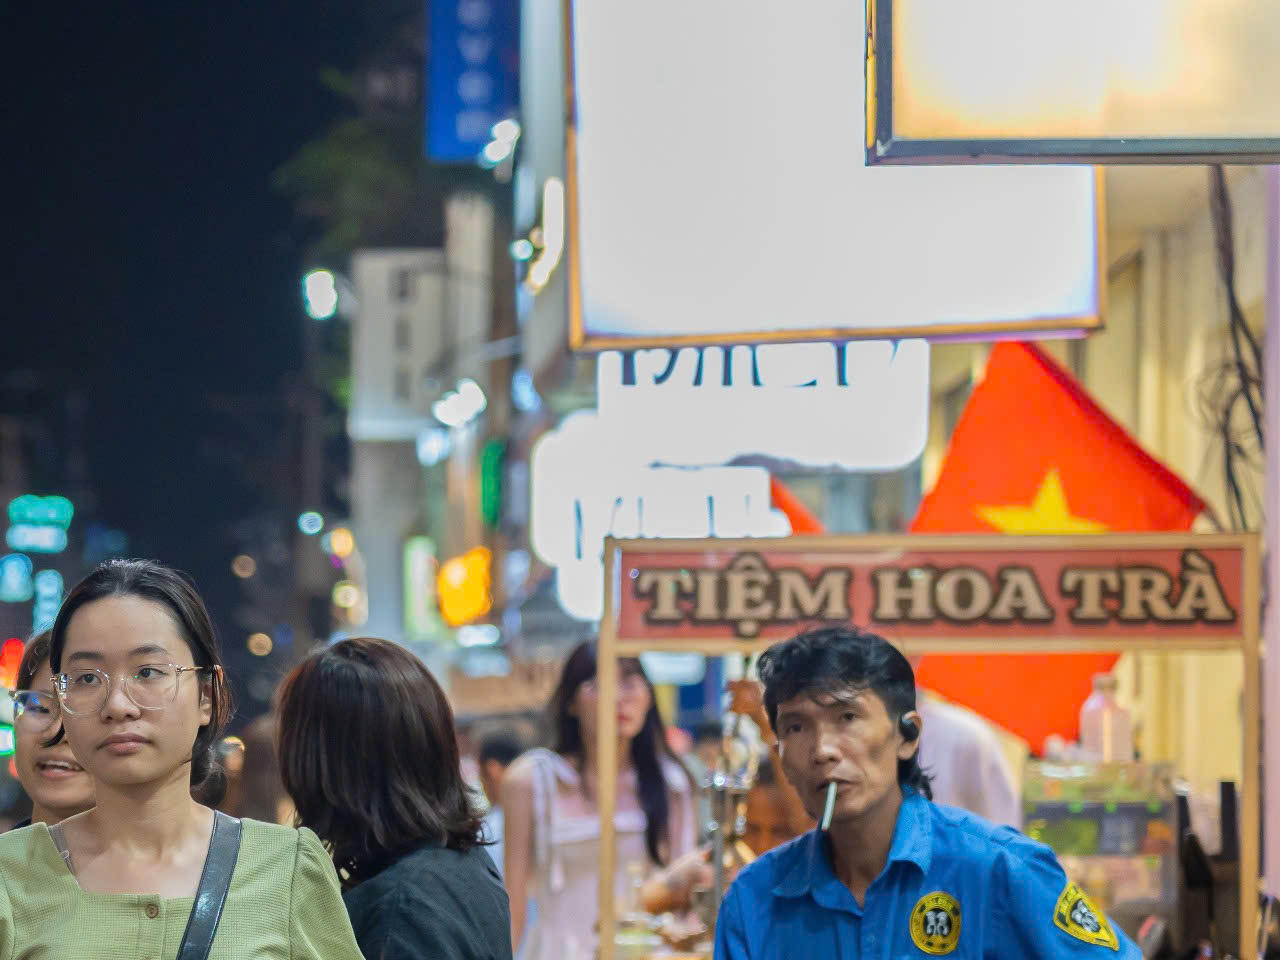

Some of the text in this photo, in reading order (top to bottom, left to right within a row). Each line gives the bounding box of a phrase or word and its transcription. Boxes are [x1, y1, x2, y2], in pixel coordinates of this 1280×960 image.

[634, 549, 1235, 639] TIỆM HOA TRÀ
